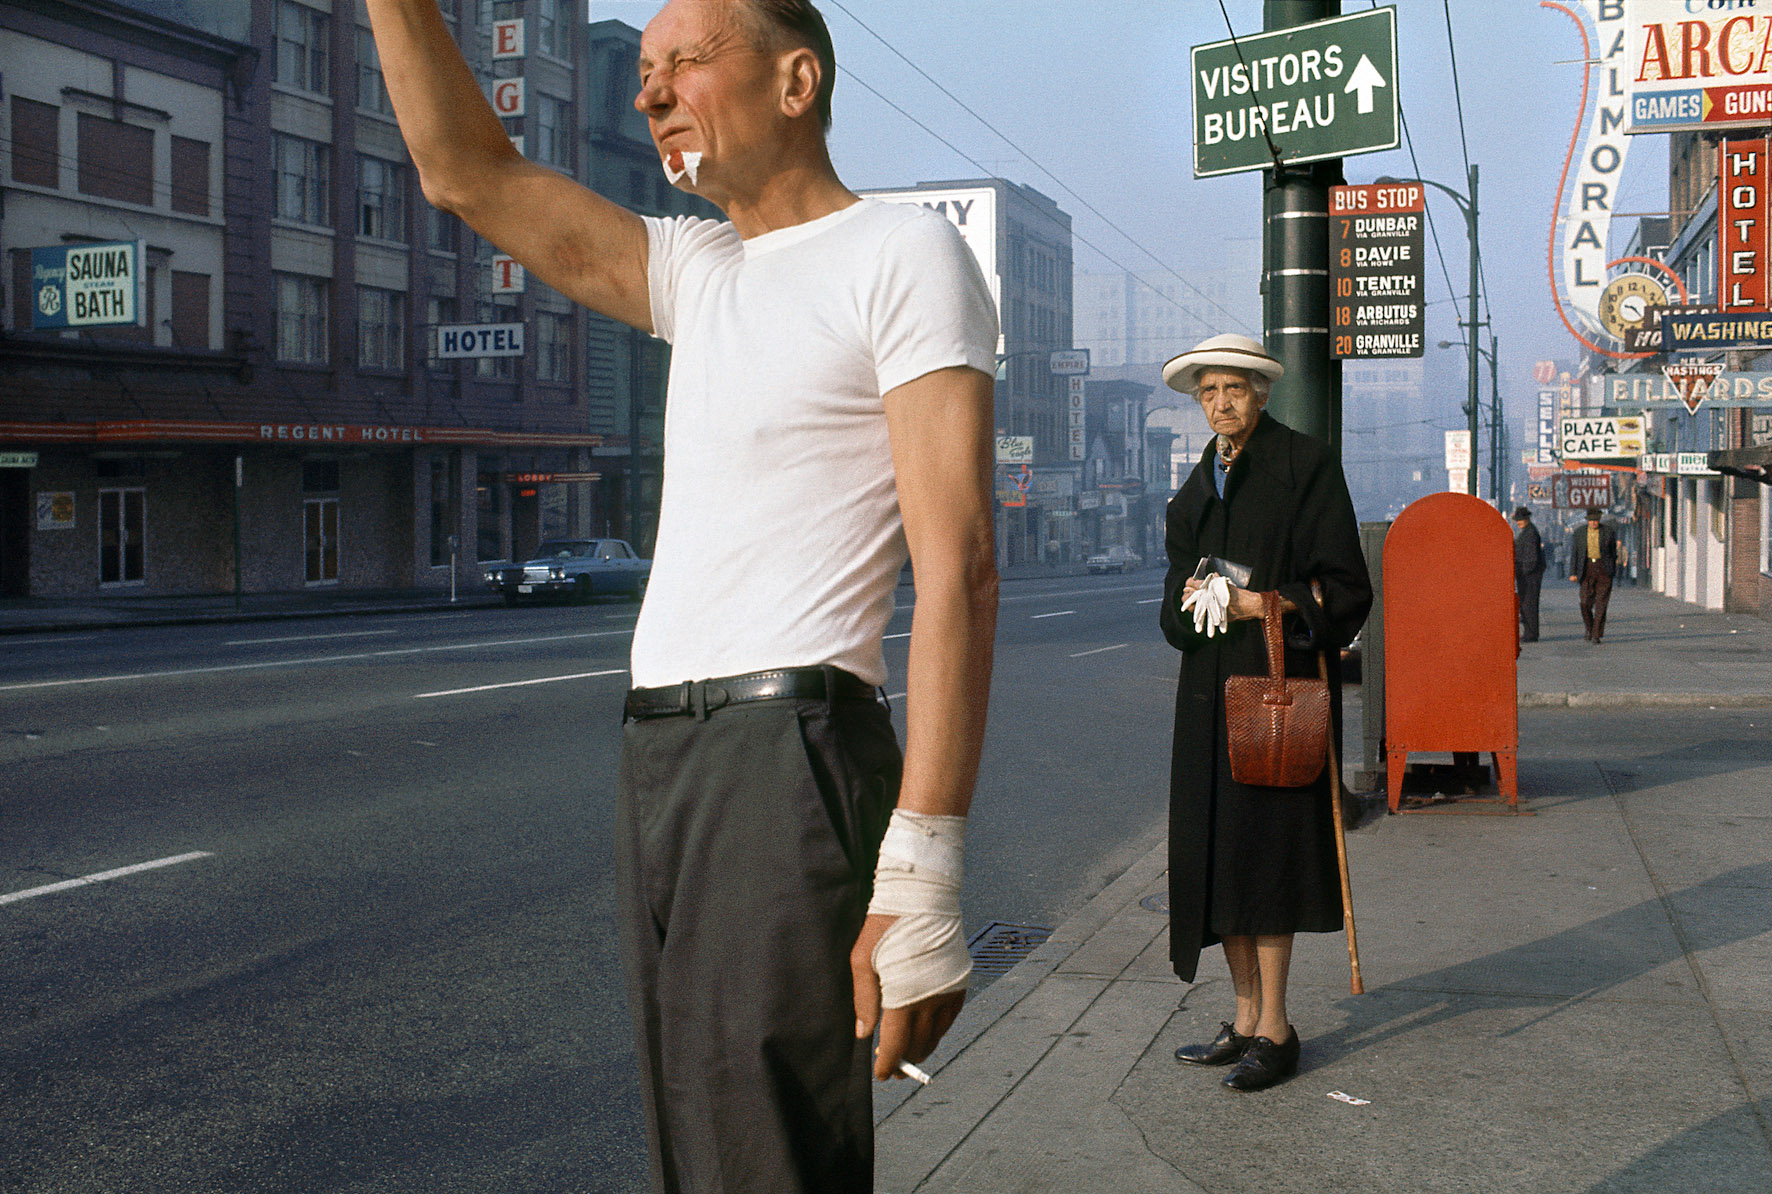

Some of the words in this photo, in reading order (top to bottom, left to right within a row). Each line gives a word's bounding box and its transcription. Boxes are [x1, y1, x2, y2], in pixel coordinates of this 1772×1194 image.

[1200, 44, 1343, 100] VISITORS
[1635, 94, 1700, 120] GAMES
[1204, 93, 1335, 145] BUREAU
[1570, 0, 1624, 287] BALMORAL
[495, 24, 520, 289] EGT
[1335, 190, 1367, 211] BUS
[1377, 187, 1419, 209] STOP
[1340, 219, 1350, 239] 7
[1355, 216, 1417, 233] DUNBAR
[1371, 230, 1410, 238] GRANVILLE
[1733, 152, 1757, 306] HOTEL
[1340, 248, 1351, 267] 8
[1356, 246, 1411, 262] DAVIE
[71, 251, 128, 281] SAUNA
[83, 281, 114, 289] STEAM
[1337, 278, 1352, 297] 10
[1356, 275, 1416, 290] TENTH
[1628, 282, 1637, 291] 12
[1642, 285, 1646, 293] 1
[1371, 289, 1410, 297] GRANVILLE
[1609, 294, 1617, 303] 10
[1650, 292, 1656, 301] 2
[75, 289, 124, 318] BATH
[1608, 305, 1614, 314] 9
[1336, 306, 1351, 326] 18
[1356, 304, 1417, 320] ARBUTUS
[1610, 315, 1616, 324] 8
[1618, 323, 1624, 332] 7
[1672, 321, 1772, 341] WASHING
[444, 329, 520, 353] HOTEL
[1336, 335, 1352, 355] 20
[1356, 333, 1419, 349] GRANVILLE
[1372, 347, 1411, 355] GRANVILLE
[1051, 361, 1084, 369] EMPIRE
[1680, 357, 1706, 365] NEW
[1666, 366, 1721, 376] HASTINGS
[1613, 376, 1772, 401] BILLIARDS
[1072, 378, 1081, 458] HOTEL
[260, 425, 346, 440] REGENT
[361, 427, 423, 441] HOTEL
[1564, 422, 1616, 436] PLAZA
[998, 437, 1023, 449] Blue
[1564, 438, 1617, 453] CAFE
[1009, 446, 1031, 459] Eagle
[518, 474, 552, 482] LOBBY
[1571, 478, 1607, 487] WESTERN
[1570, 488, 1608, 506] GYM
